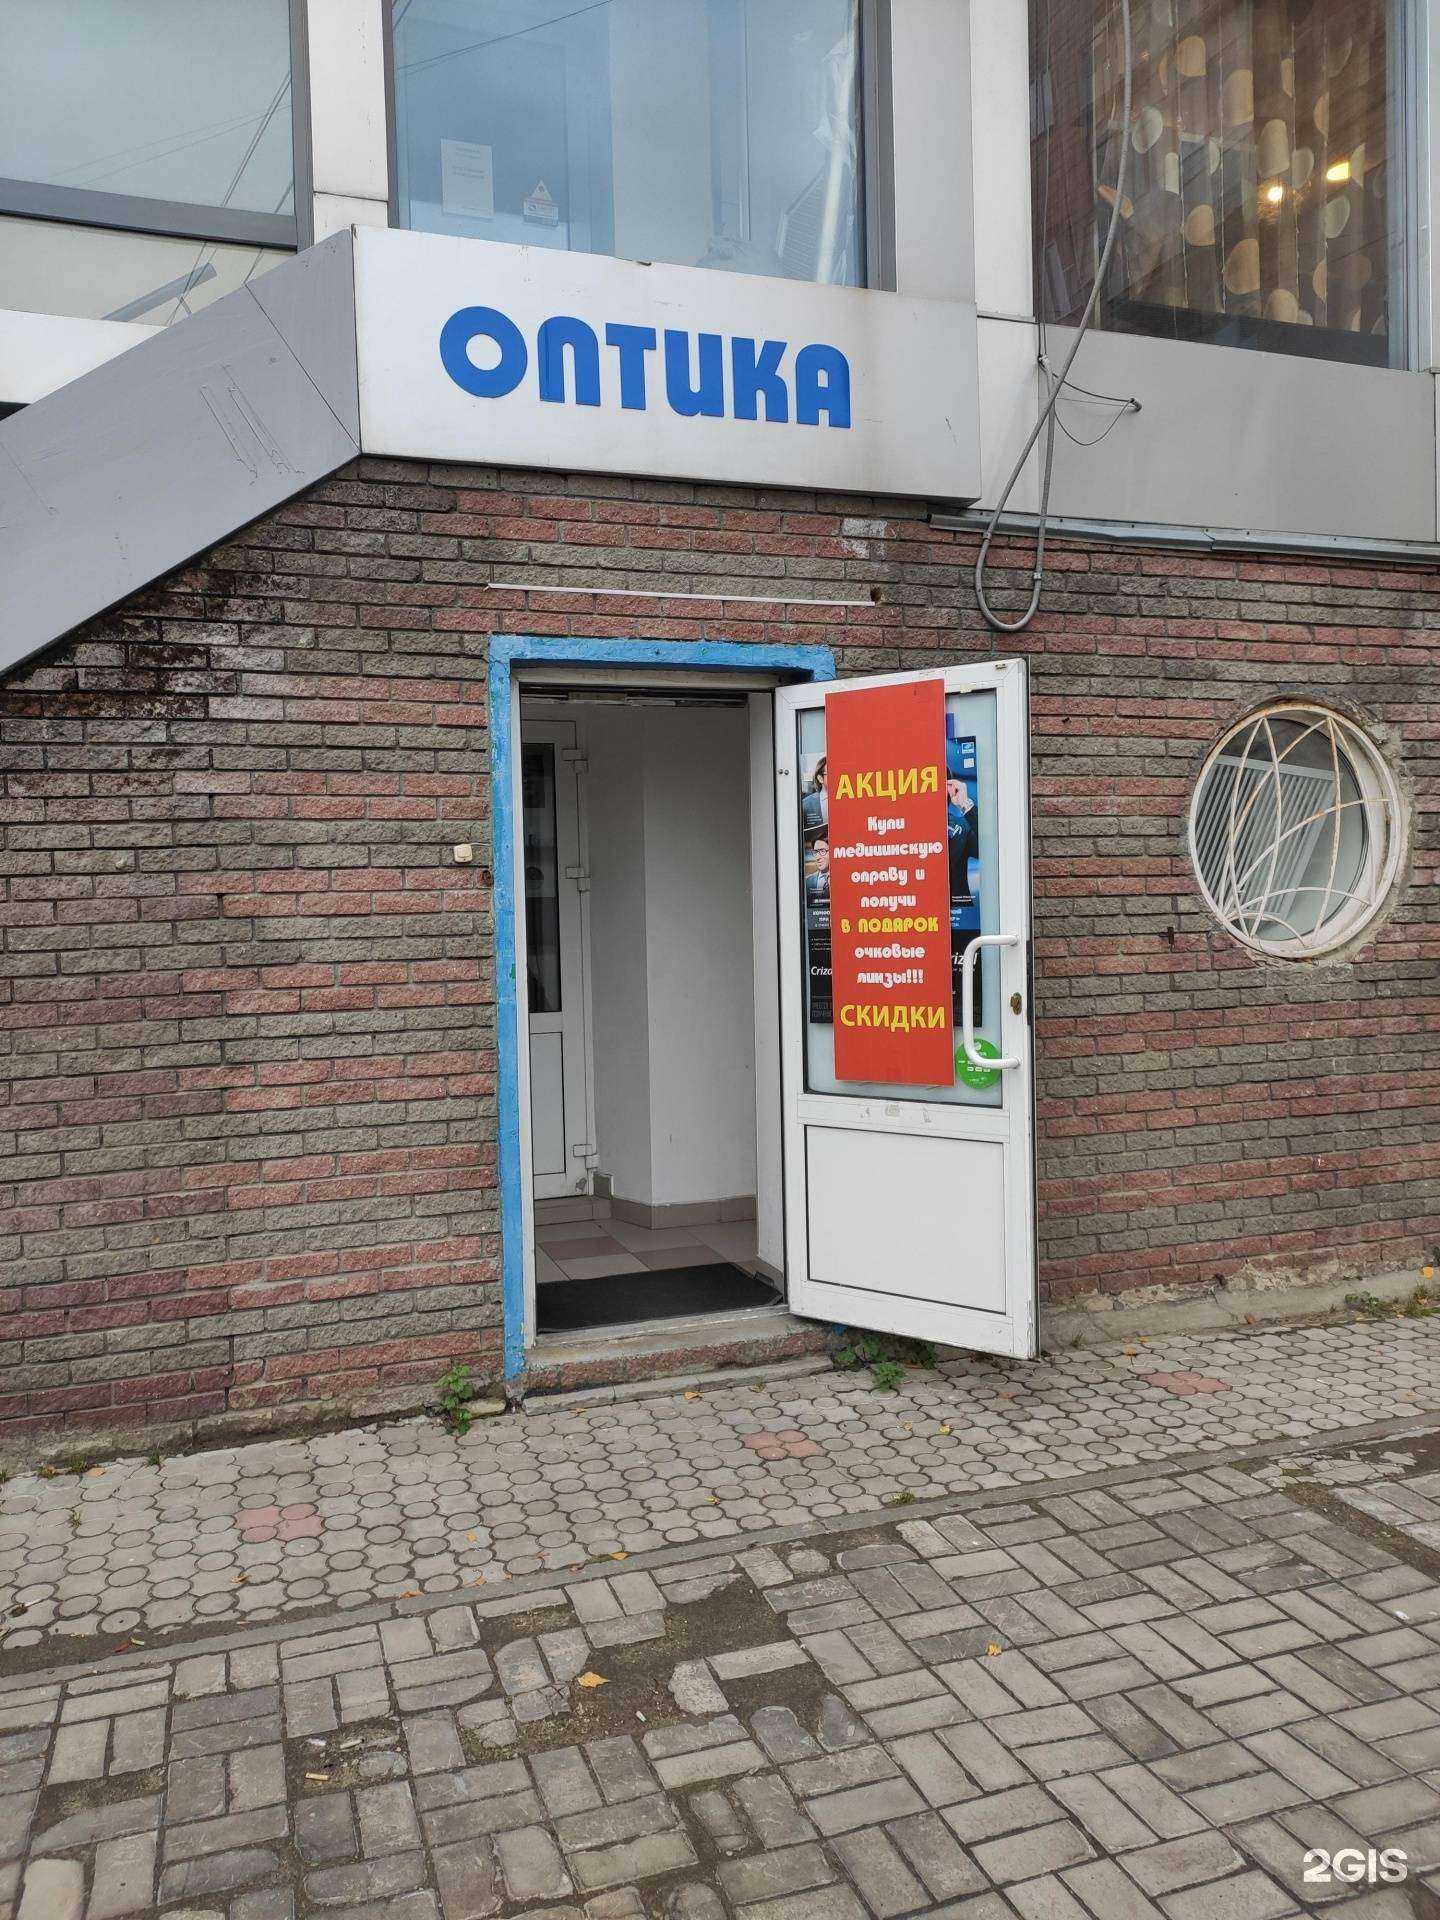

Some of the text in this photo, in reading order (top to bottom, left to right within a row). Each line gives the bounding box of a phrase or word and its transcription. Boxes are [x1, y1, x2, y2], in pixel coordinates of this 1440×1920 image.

[438, 305, 851, 429] ОПТИКА
[834, 765, 939, 802] АКЦИЯ
[867, 816, 906, 835] Купи
[833, 841, 944, 859] медицинскую
[851, 866, 926, 886] оправу и
[860, 895, 917, 912] получи
[858, 916, 939, 933] ПОДАРОК
[854, 943, 926, 959] очковые
[857, 968, 924, 989] линзы!!!
[840, 1004, 946, 1033] СКИДКИ
